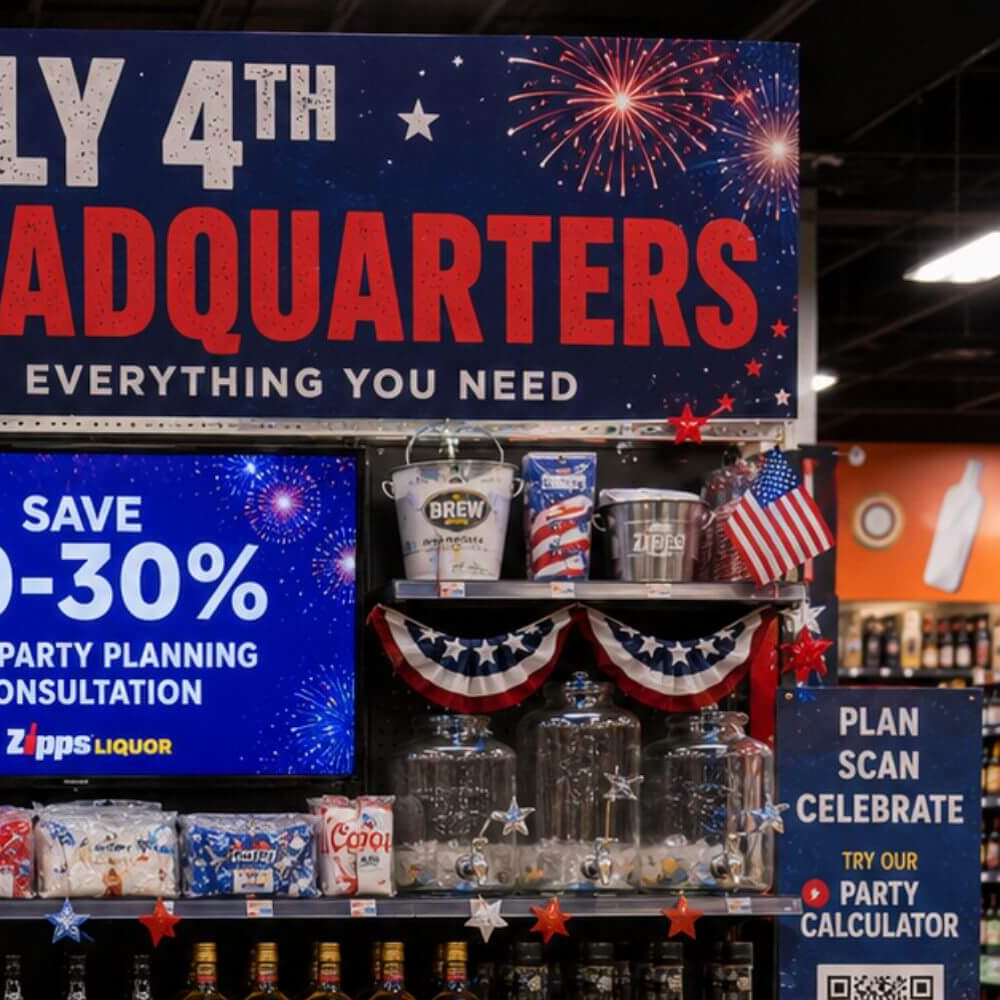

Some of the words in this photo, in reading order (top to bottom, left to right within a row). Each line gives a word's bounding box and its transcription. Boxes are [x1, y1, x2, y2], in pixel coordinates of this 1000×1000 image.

[162, 60, 337, 190] 4TH
[26, 364, 323, 398] EVERYTHING
[344, 368, 437, 399] YOU
[459, 370, 578, 401] NEED
[22, 495, 142, 533] SAVE
[430, 501, 485, 519] BREW
[103, 641, 258, 668] PLANNING
[839, 707, 919, 736] PLAN
[6, 722, 91, 761] Zipps
[94, 738, 173, 757] LIQUOR
[838, 750, 919, 780] SCAN
[796, 793, 964, 824] CELEBRATE
[842, 851, 875, 870] TRY
[881, 851, 918, 870] OUR
[840, 880, 919, 906] PARTY
[801, 912, 959, 938] CALCULATOR
